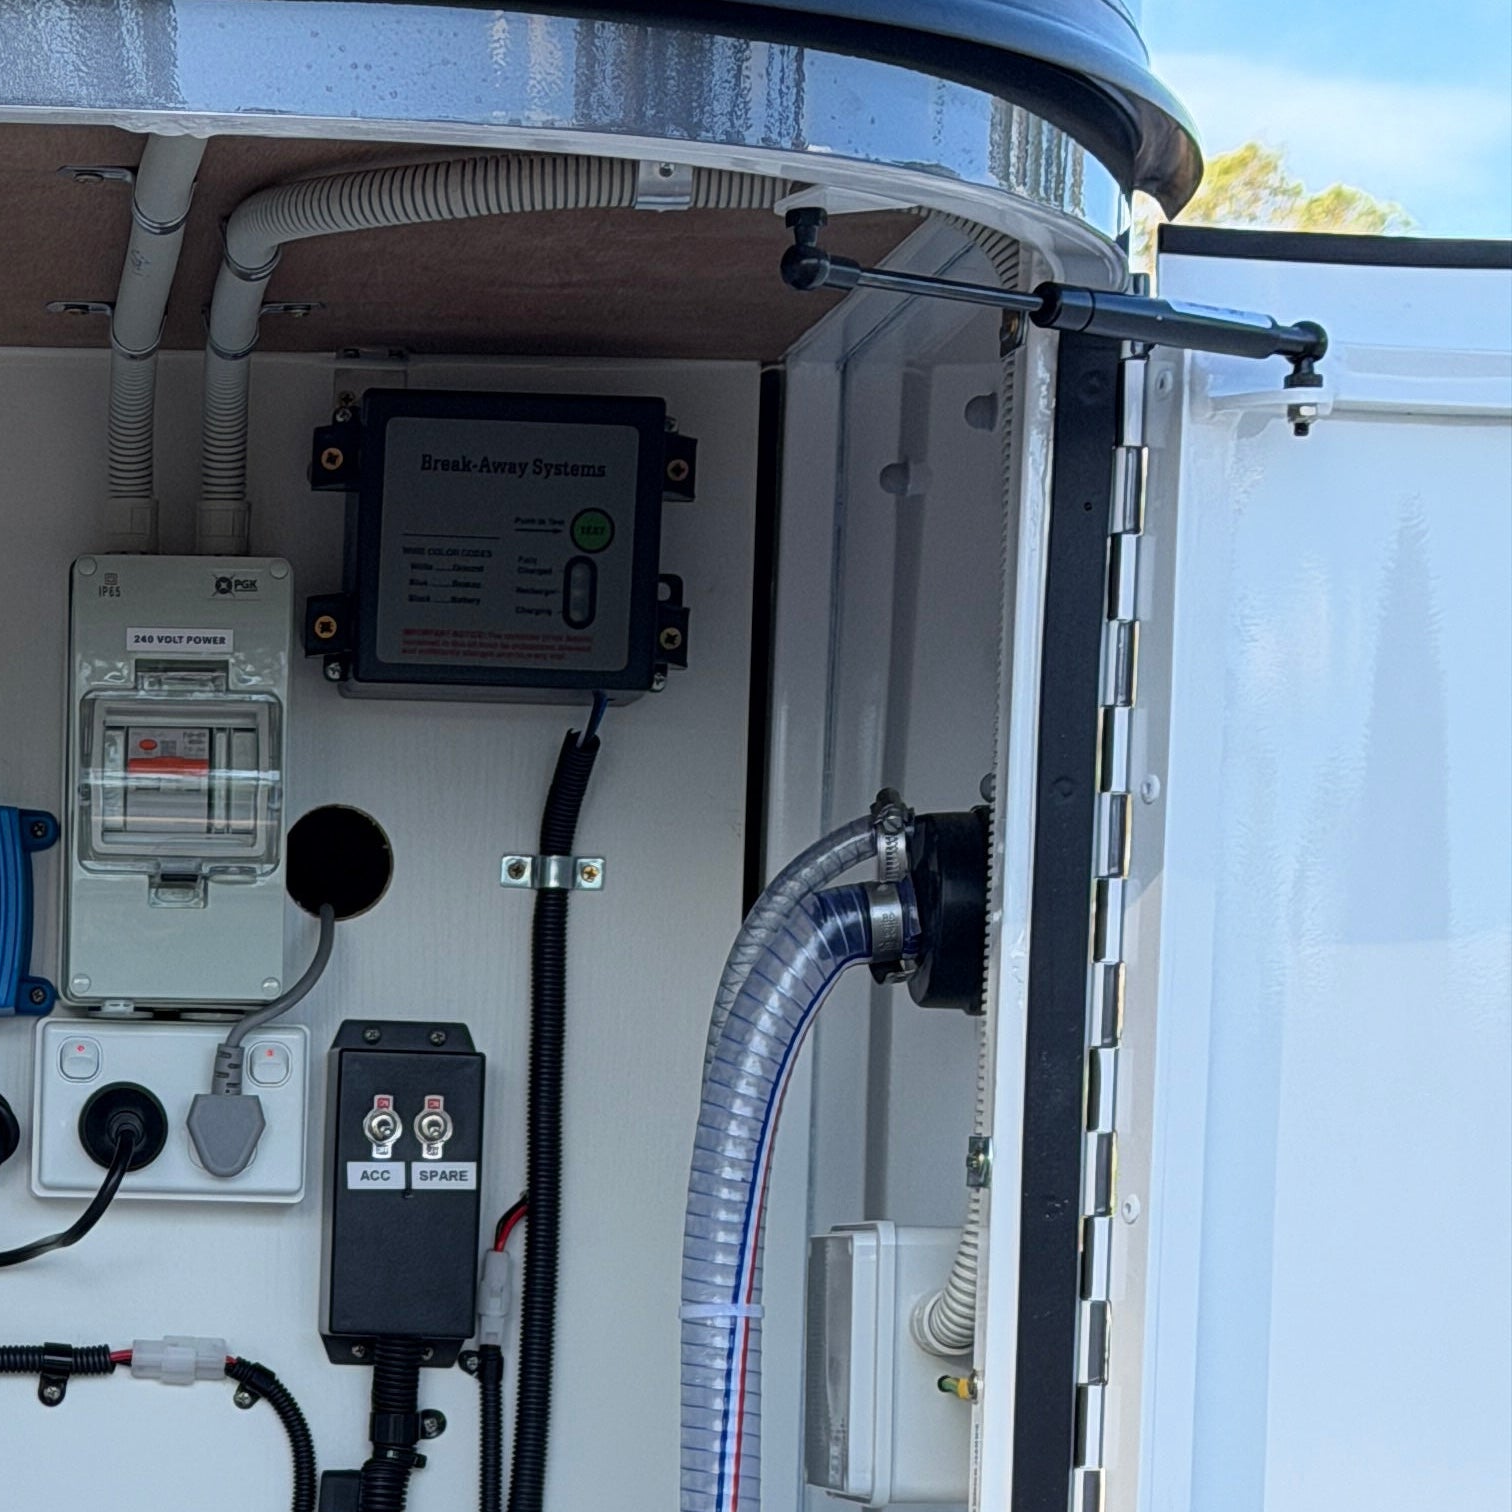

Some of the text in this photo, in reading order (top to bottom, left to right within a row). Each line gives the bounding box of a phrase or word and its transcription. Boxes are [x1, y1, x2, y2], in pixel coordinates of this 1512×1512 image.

[420, 453, 606, 479] Break-Away Systems
[98, 585, 121, 598] IP65
[156, 635, 184, 644] VOLT
[187, 635, 226, 645] POWER
[360, 1169, 391, 1182] ACC
[419, 1170, 469, 1182] SPARE
